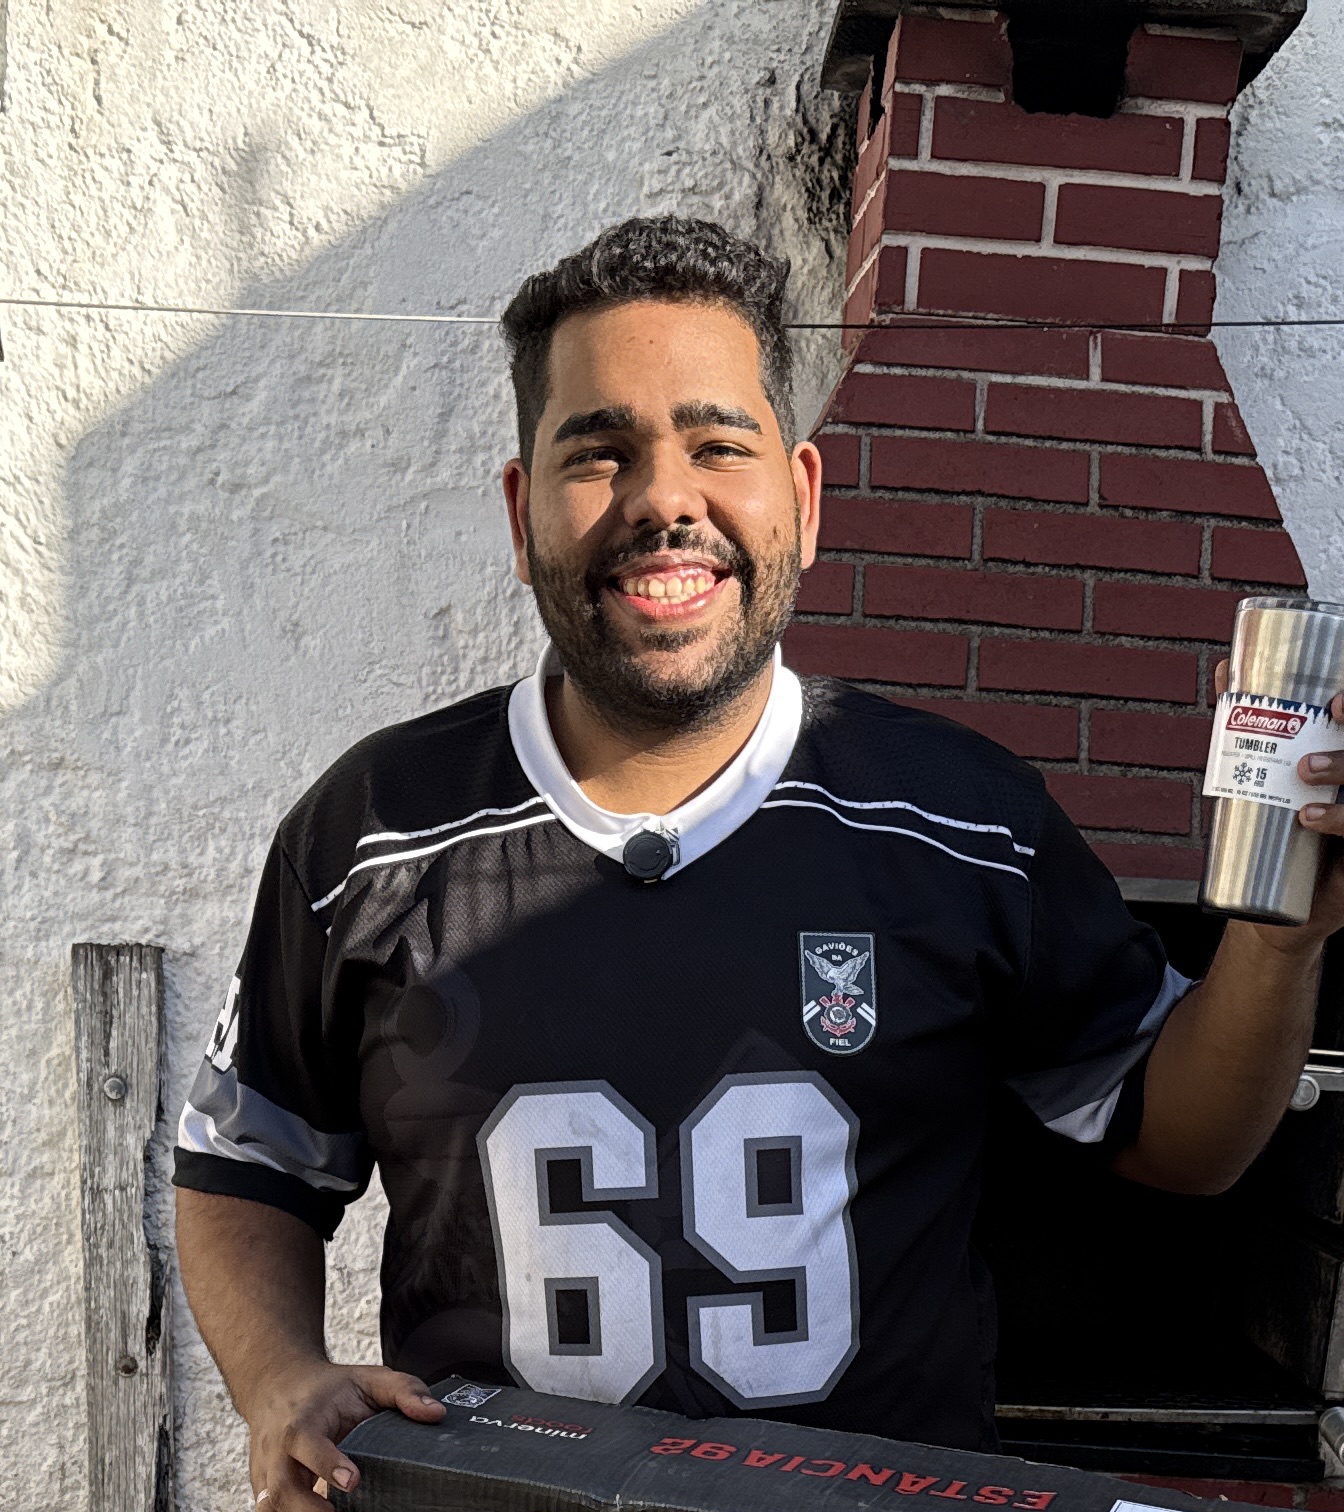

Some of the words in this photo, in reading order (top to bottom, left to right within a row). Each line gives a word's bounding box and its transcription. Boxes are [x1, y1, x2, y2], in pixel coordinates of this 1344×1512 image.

[1231, 707, 1287, 731] Coleman
[1235, 737, 1278, 755] TUMBLER
[1256, 767, 1269, 781] 15
[815, 941, 859, 957] GAVIÕES
[829, 1037, 852, 1047] FIEL
[477, 1070, 860, 1411] 69
[469, 1416, 587, 1440] minerva
